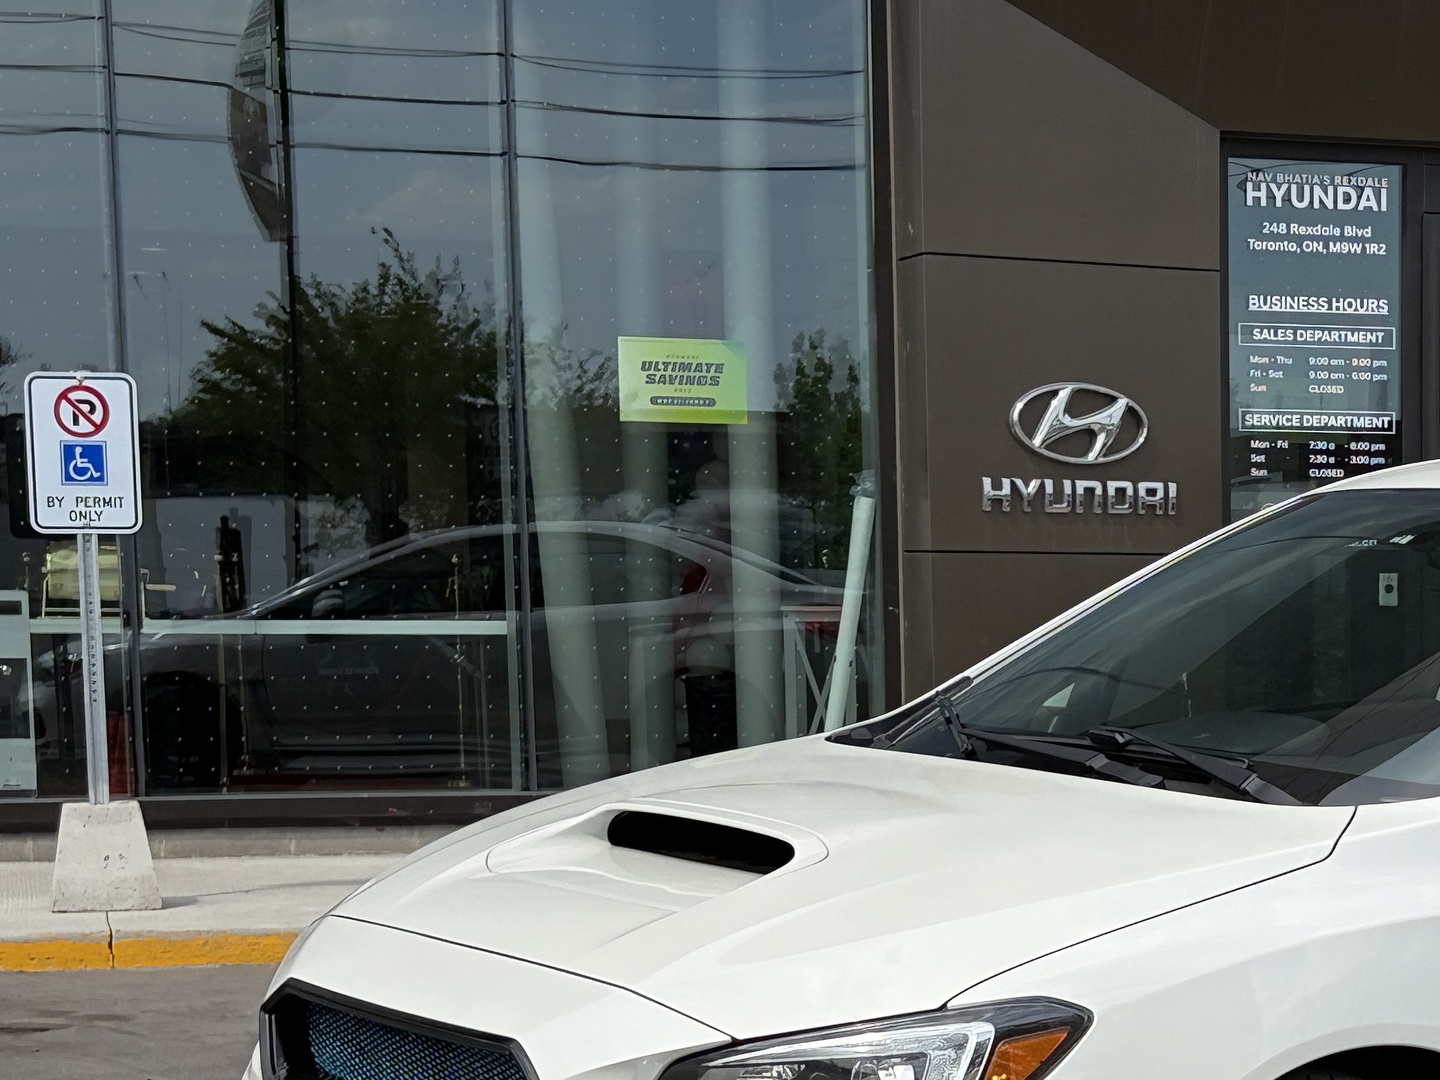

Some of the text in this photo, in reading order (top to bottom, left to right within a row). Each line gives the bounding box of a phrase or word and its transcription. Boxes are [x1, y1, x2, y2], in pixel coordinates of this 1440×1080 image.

[1247, 171, 1389, 188] NAV BHATIA'S REXDALE
[1246, 181, 1388, 212] HYUNDAI
[1262, 221, 1372, 238] 248 Rexdale Blvd
[1247, 238, 1387, 256] Toronto, ON, M9W 1R2
[1248, 294, 1389, 315] BUSINESS HOURS
[1252, 328, 1385, 344] SALES DEPARTMENT
[640, 360, 725, 374] ULTIMATE
[645, 373, 720, 386] SAVINGS
[1250, 383, 1345, 394] Sun CLOSED
[1244, 414, 1391, 429] SERVICE DEPARTMENT
[1250, 440, 1270, 449] Mon
[1250, 467, 1345, 478] Sun CLOSED
[47, 496, 125, 509] BY PERMIT
[981, 476, 1178, 516] HYUNDAI
[69, 510, 104, 522] ONLY
